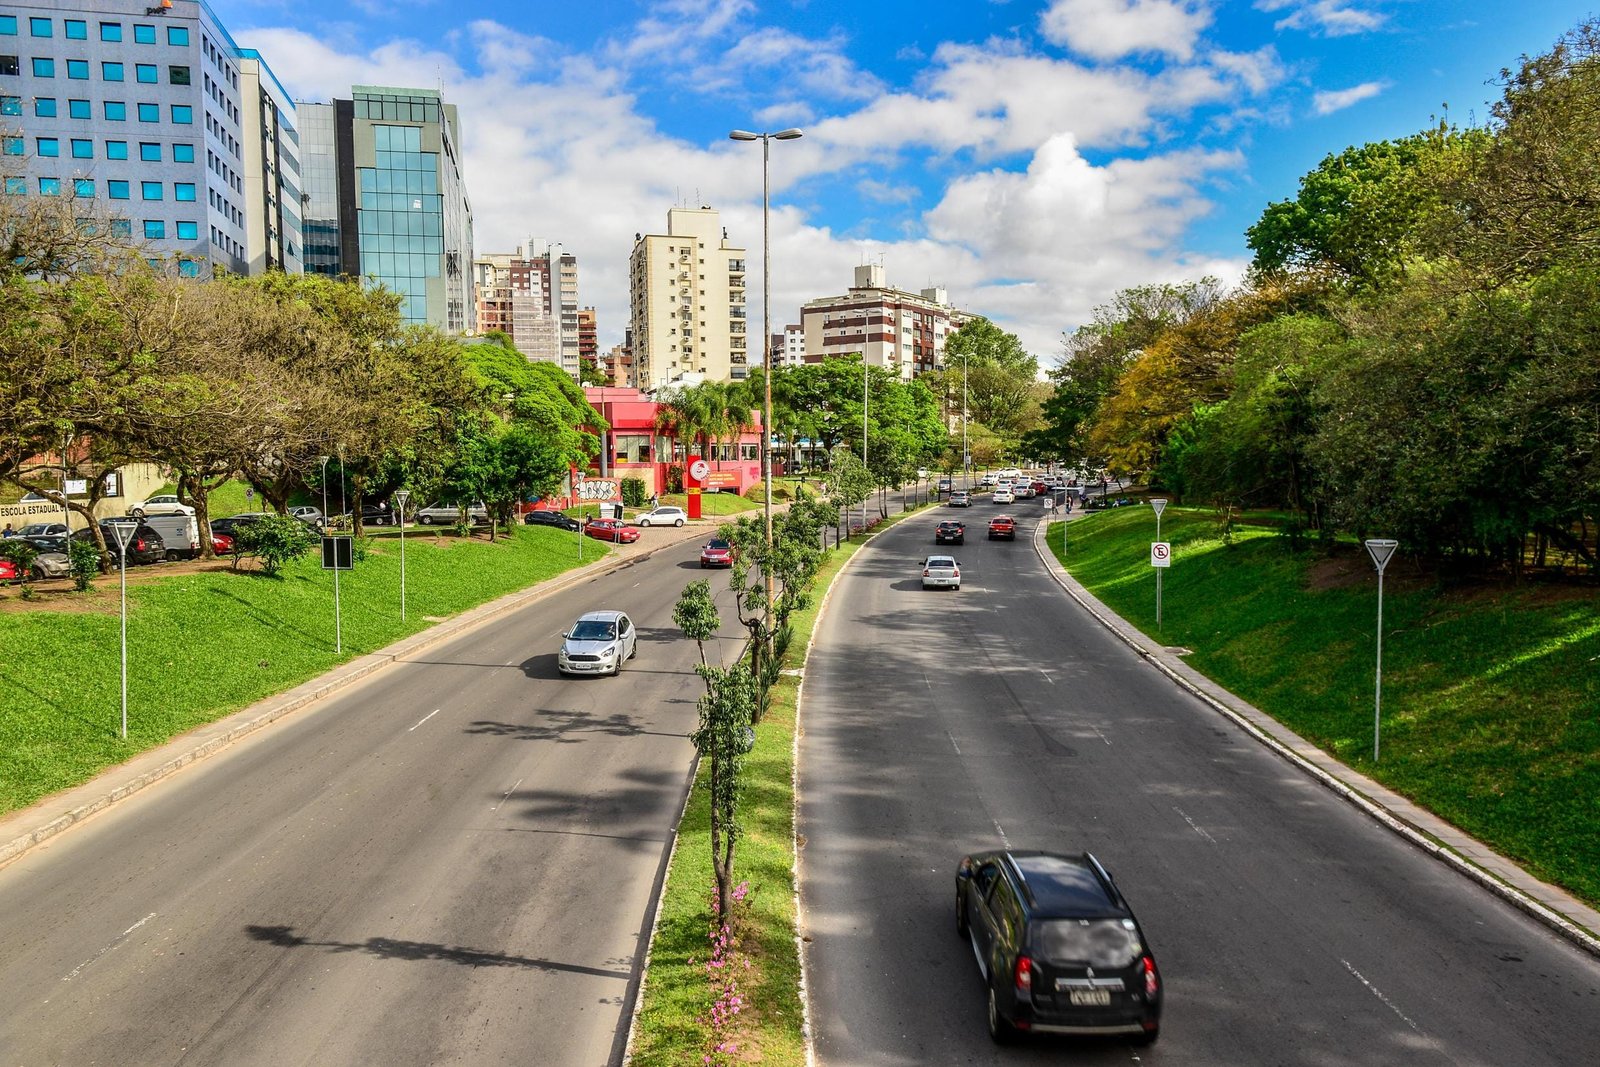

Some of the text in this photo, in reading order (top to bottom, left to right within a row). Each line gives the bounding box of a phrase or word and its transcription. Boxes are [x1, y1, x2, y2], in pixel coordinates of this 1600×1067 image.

[146, 7, 167, 16] pwc
[1, 507, 27, 516] ESCOLA
[28, 505, 59, 515] ESTADUAL
